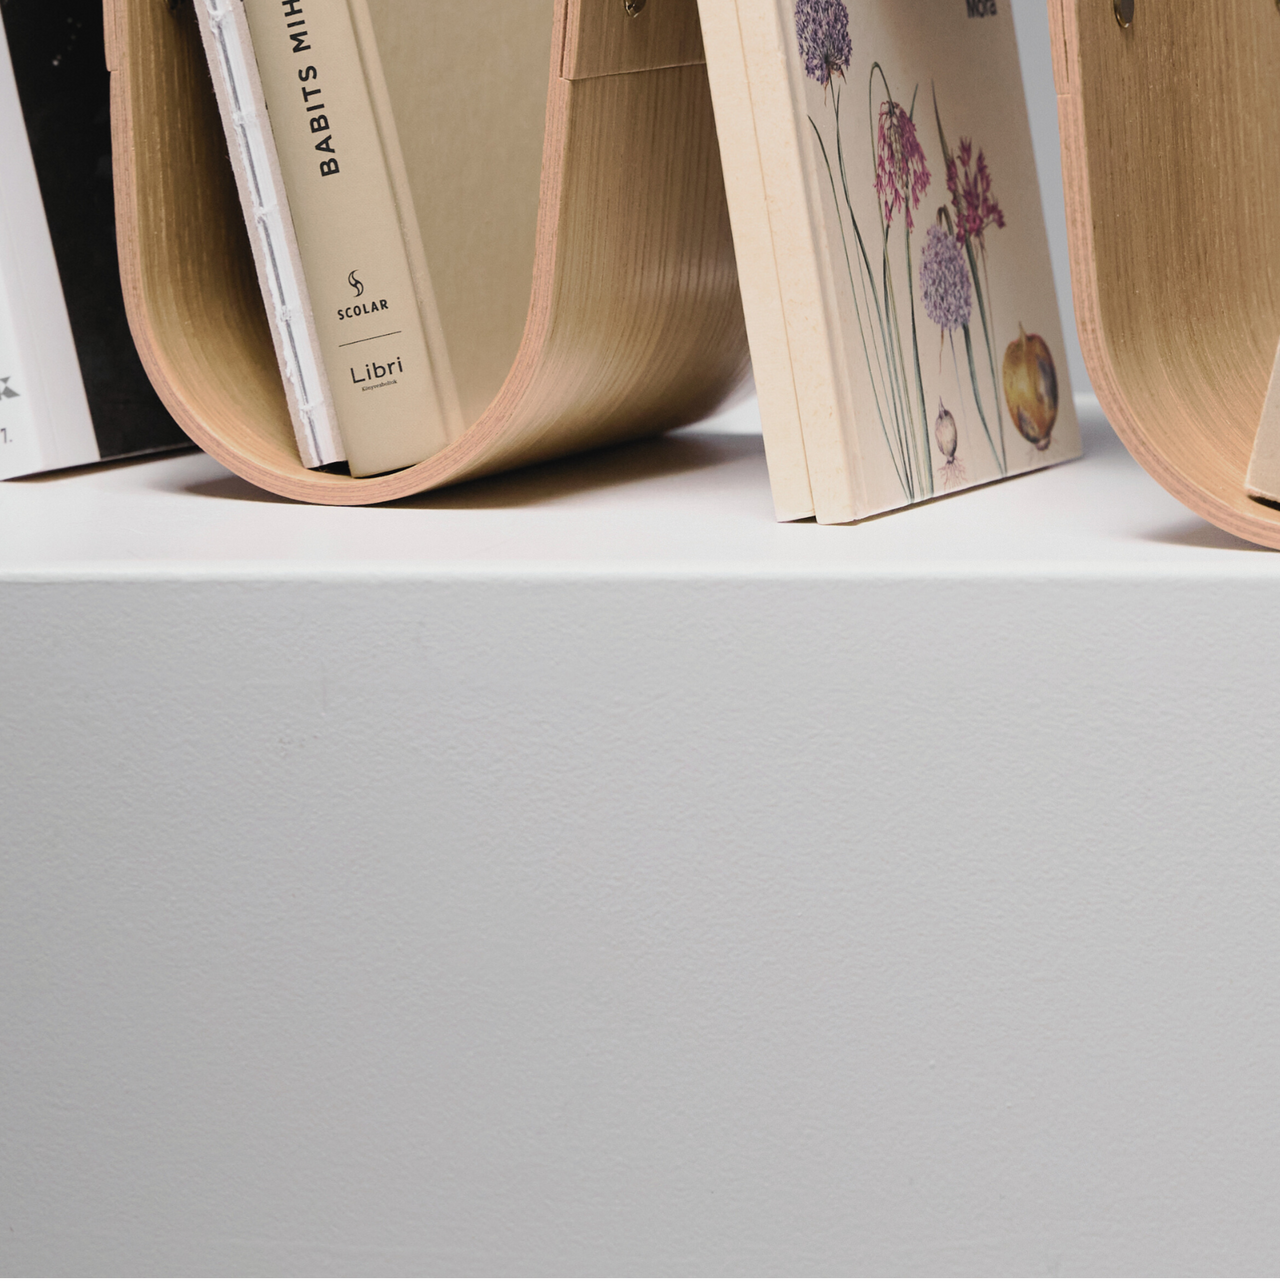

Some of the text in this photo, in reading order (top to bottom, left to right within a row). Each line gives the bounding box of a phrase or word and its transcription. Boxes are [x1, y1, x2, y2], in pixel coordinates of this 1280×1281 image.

[298, 65, 341, 178] BABITS
[337, 299, 389, 321] SCOLAR
[350, 357, 404, 384] Libri
